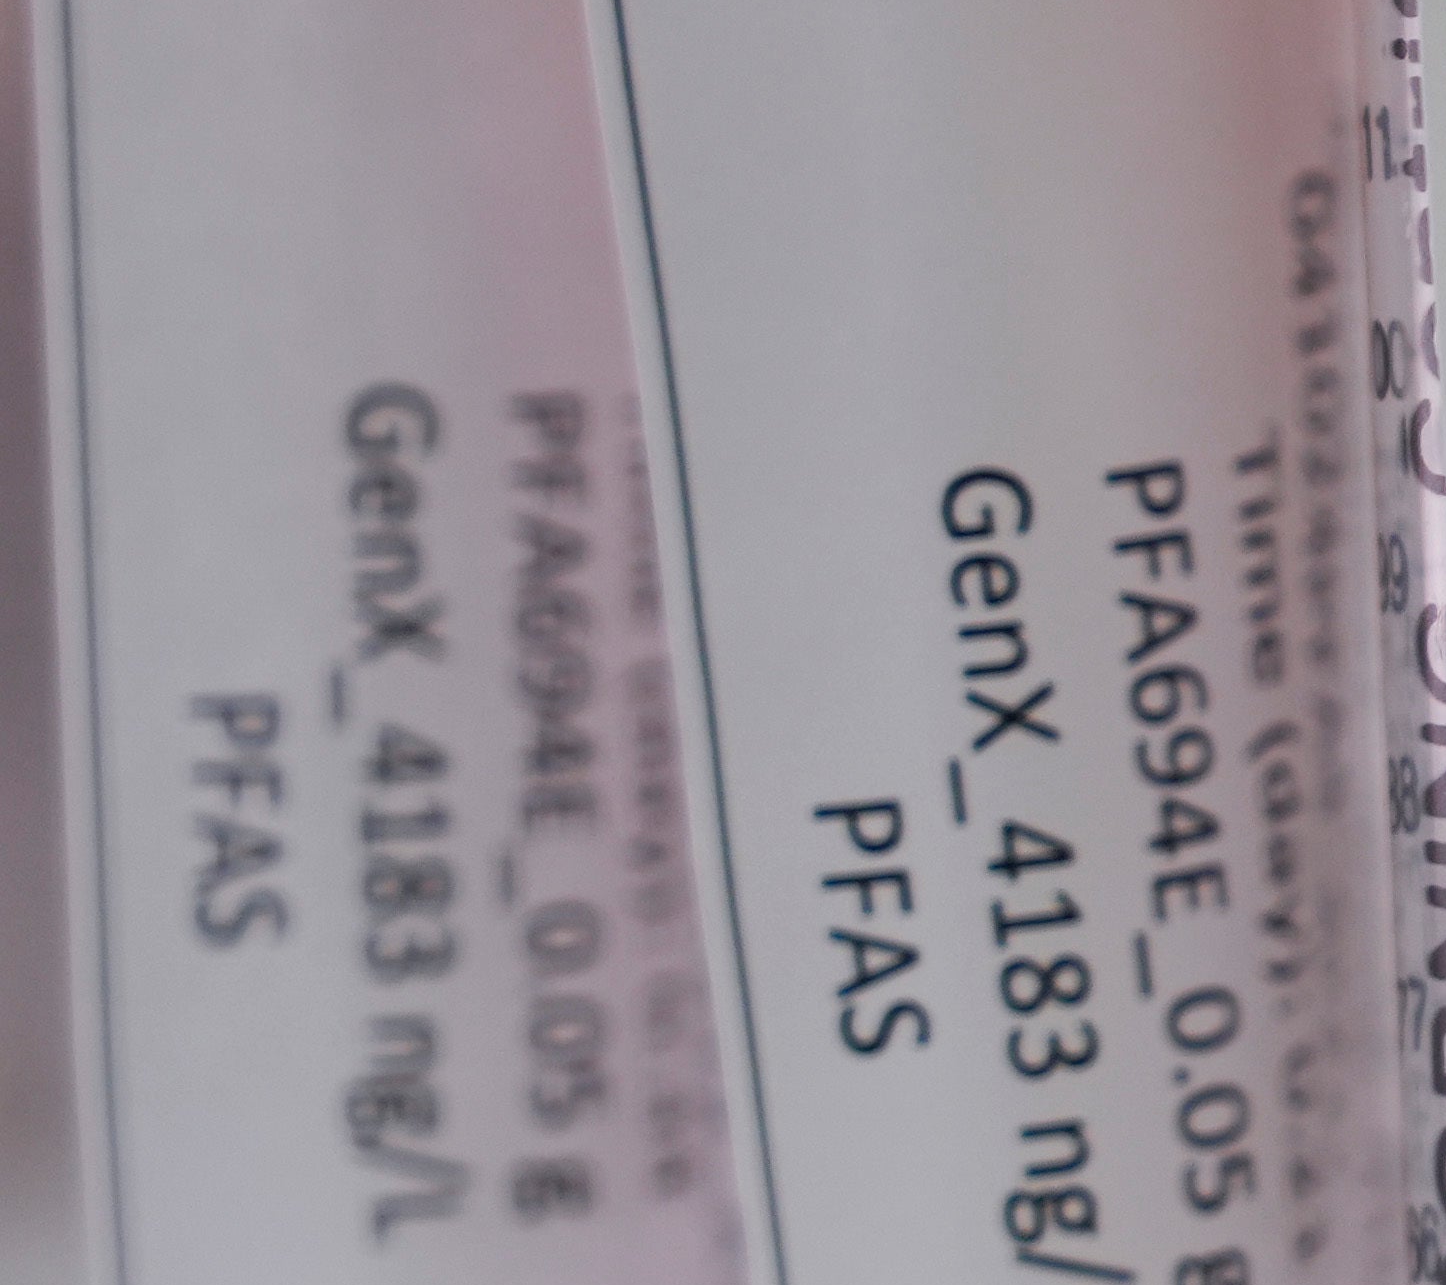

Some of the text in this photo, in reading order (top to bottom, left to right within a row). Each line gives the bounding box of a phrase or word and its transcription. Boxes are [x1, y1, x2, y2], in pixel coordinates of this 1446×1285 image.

[193, 694, 289, 953] PFAS
[814, 801, 930, 1058] PFAS
[941, 467, 1099, 1080] GenX_4183
[1106, 460, 1259, 1214] PFA694E_0.05
